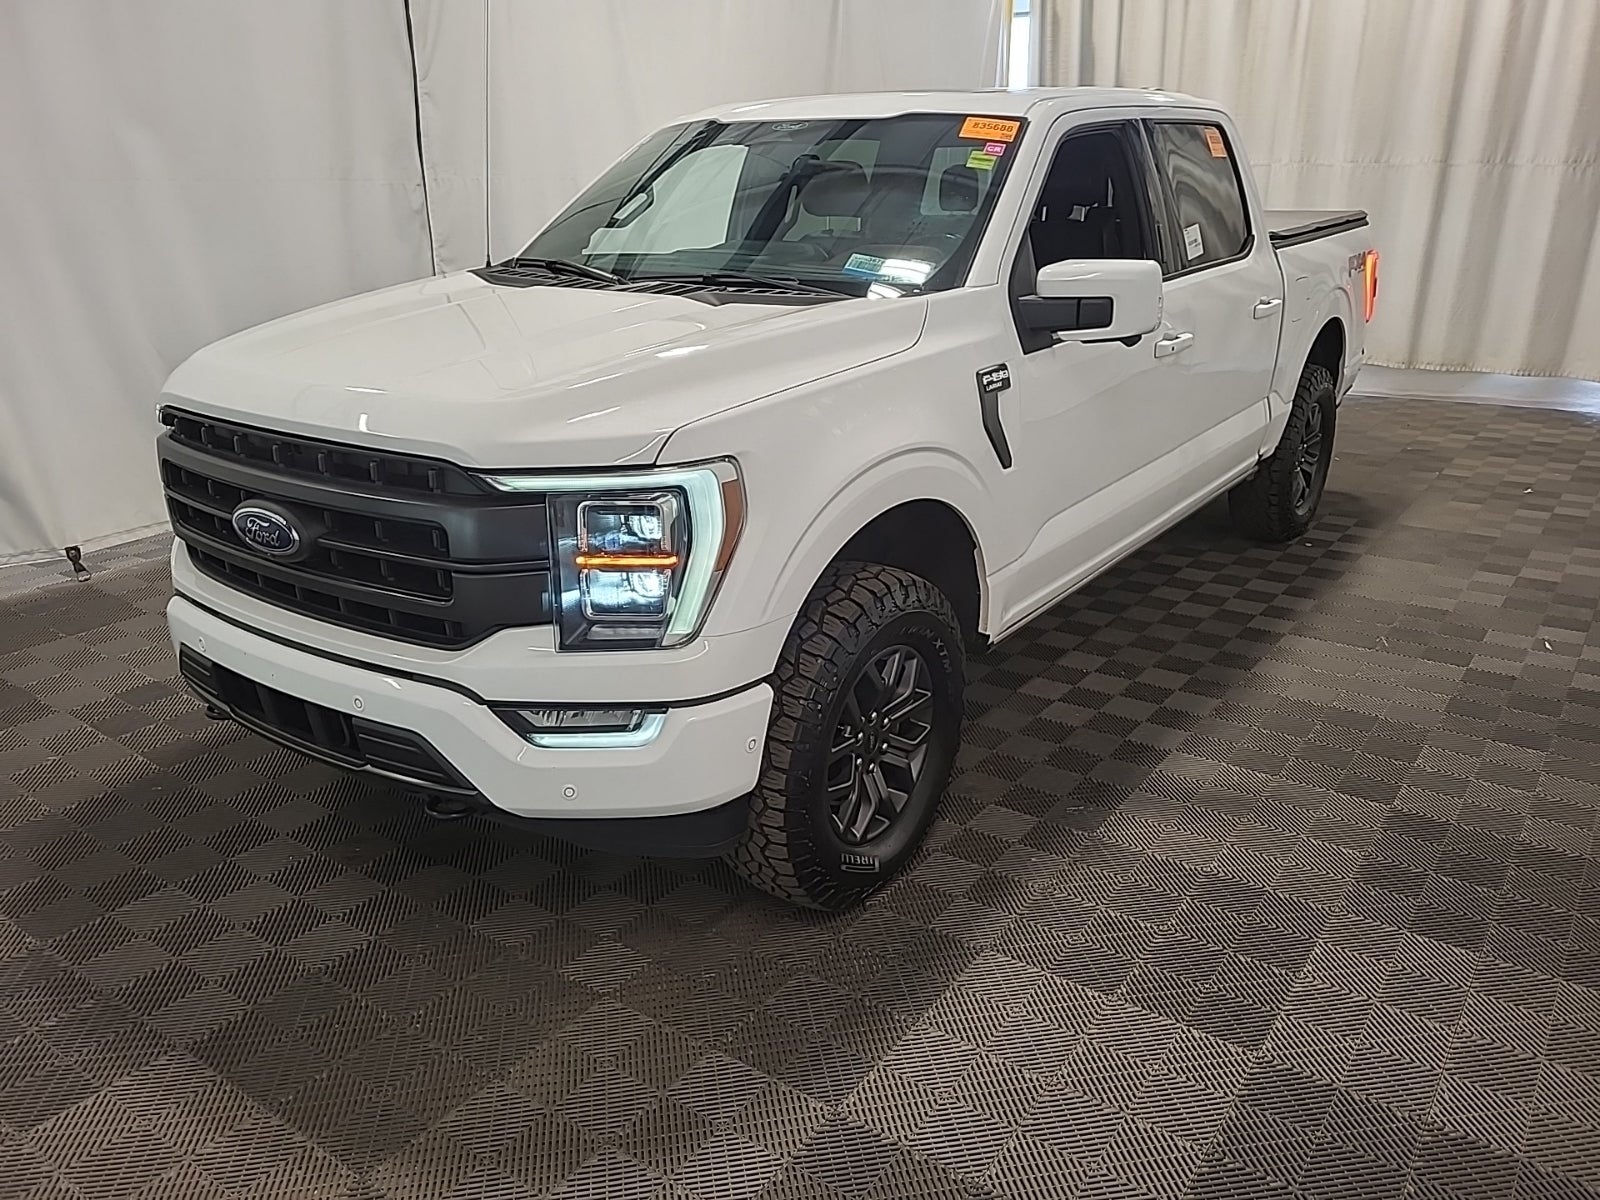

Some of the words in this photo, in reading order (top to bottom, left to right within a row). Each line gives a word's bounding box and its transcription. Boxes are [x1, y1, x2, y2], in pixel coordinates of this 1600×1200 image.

[986, 145, 1002, 153] CR
[245, 516, 281, 547] Ford
[840, 853, 880, 873] PIRELLI
